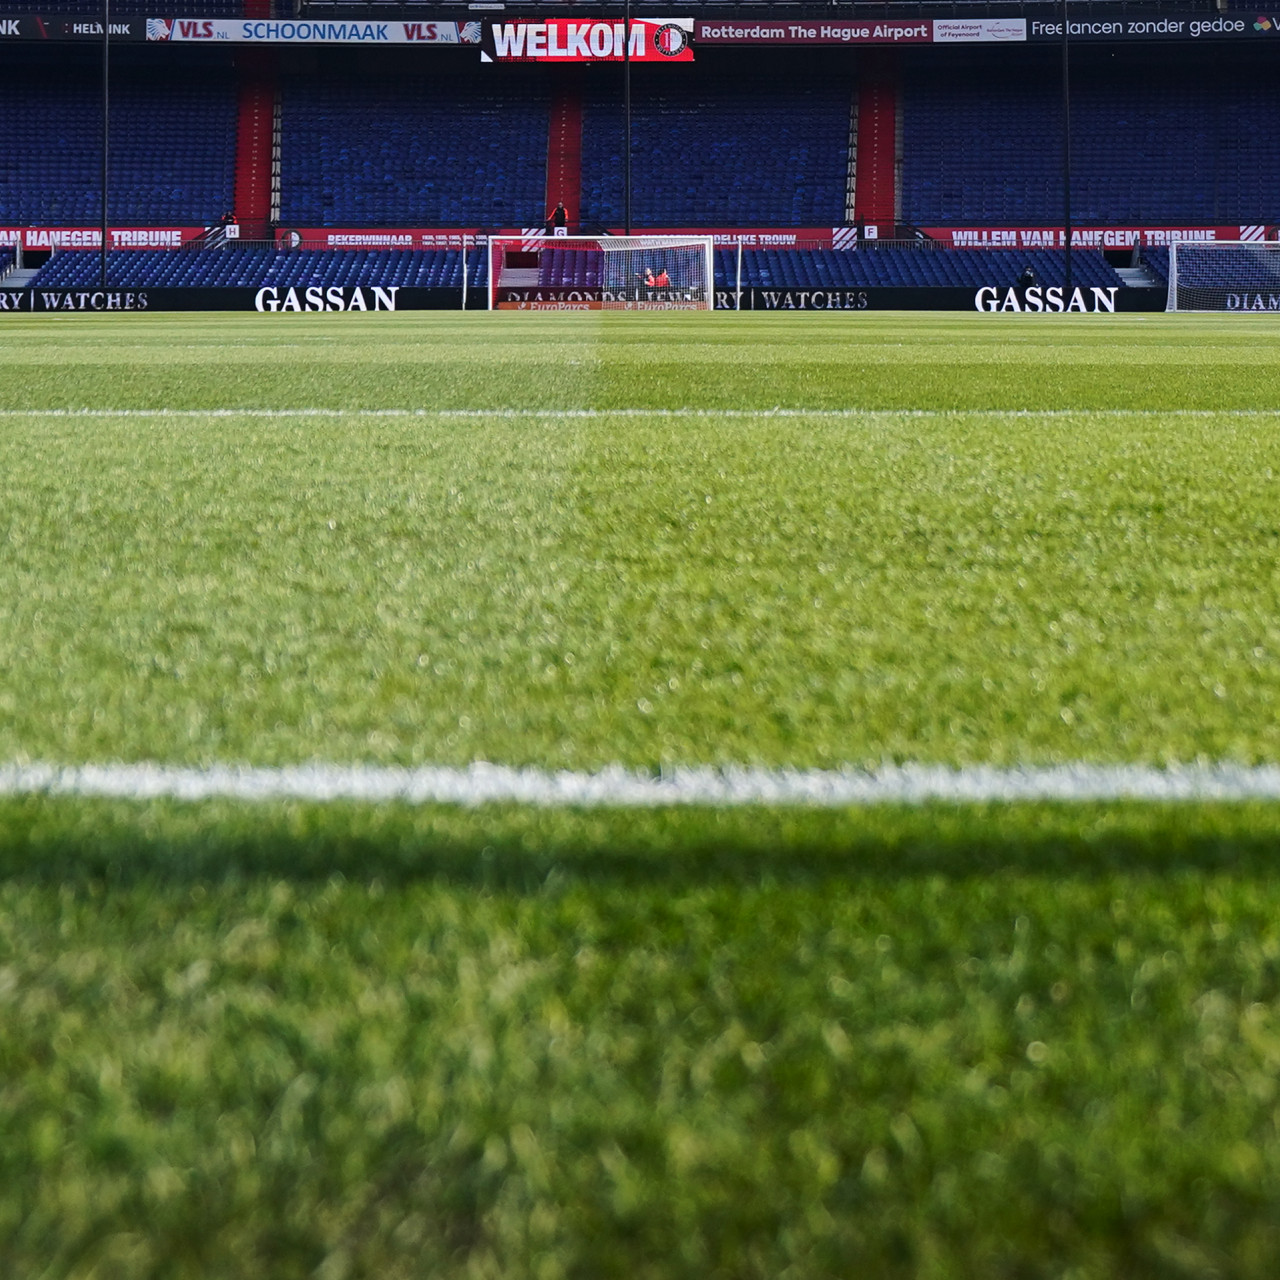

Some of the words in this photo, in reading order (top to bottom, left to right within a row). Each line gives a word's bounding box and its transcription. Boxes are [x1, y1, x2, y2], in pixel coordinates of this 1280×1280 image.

[73, 23, 130, 35] HELMINK
[242, 22, 388, 41] SCHOONMAAK
[701, 25, 785, 40] Rotterdam
[788, 25, 817, 39] The
[820, 25, 869, 42] Hague
[872, 24, 928, 41] Airport
[1031, 19, 1123, 36] Freelancen
[1127, 18, 1185, 34] zonder
[1189, 17, 1245, 37] gedoe
[492, 23, 646, 57] WELKOM
[111, 230, 182, 247] TRIBUNE
[228, 227, 237, 235] H
[952, 230, 1017, 246] WILLEM
[1021, 230, 1054, 246] VAN
[1144, 230, 1216, 246] TRIBUNE
[41, 292, 148, 310] WATCHES
[255, 286, 400, 312] GASSAN
[761, 292, 868, 309] WATCHES
[974, 286, 1119, 312] GASSAN
